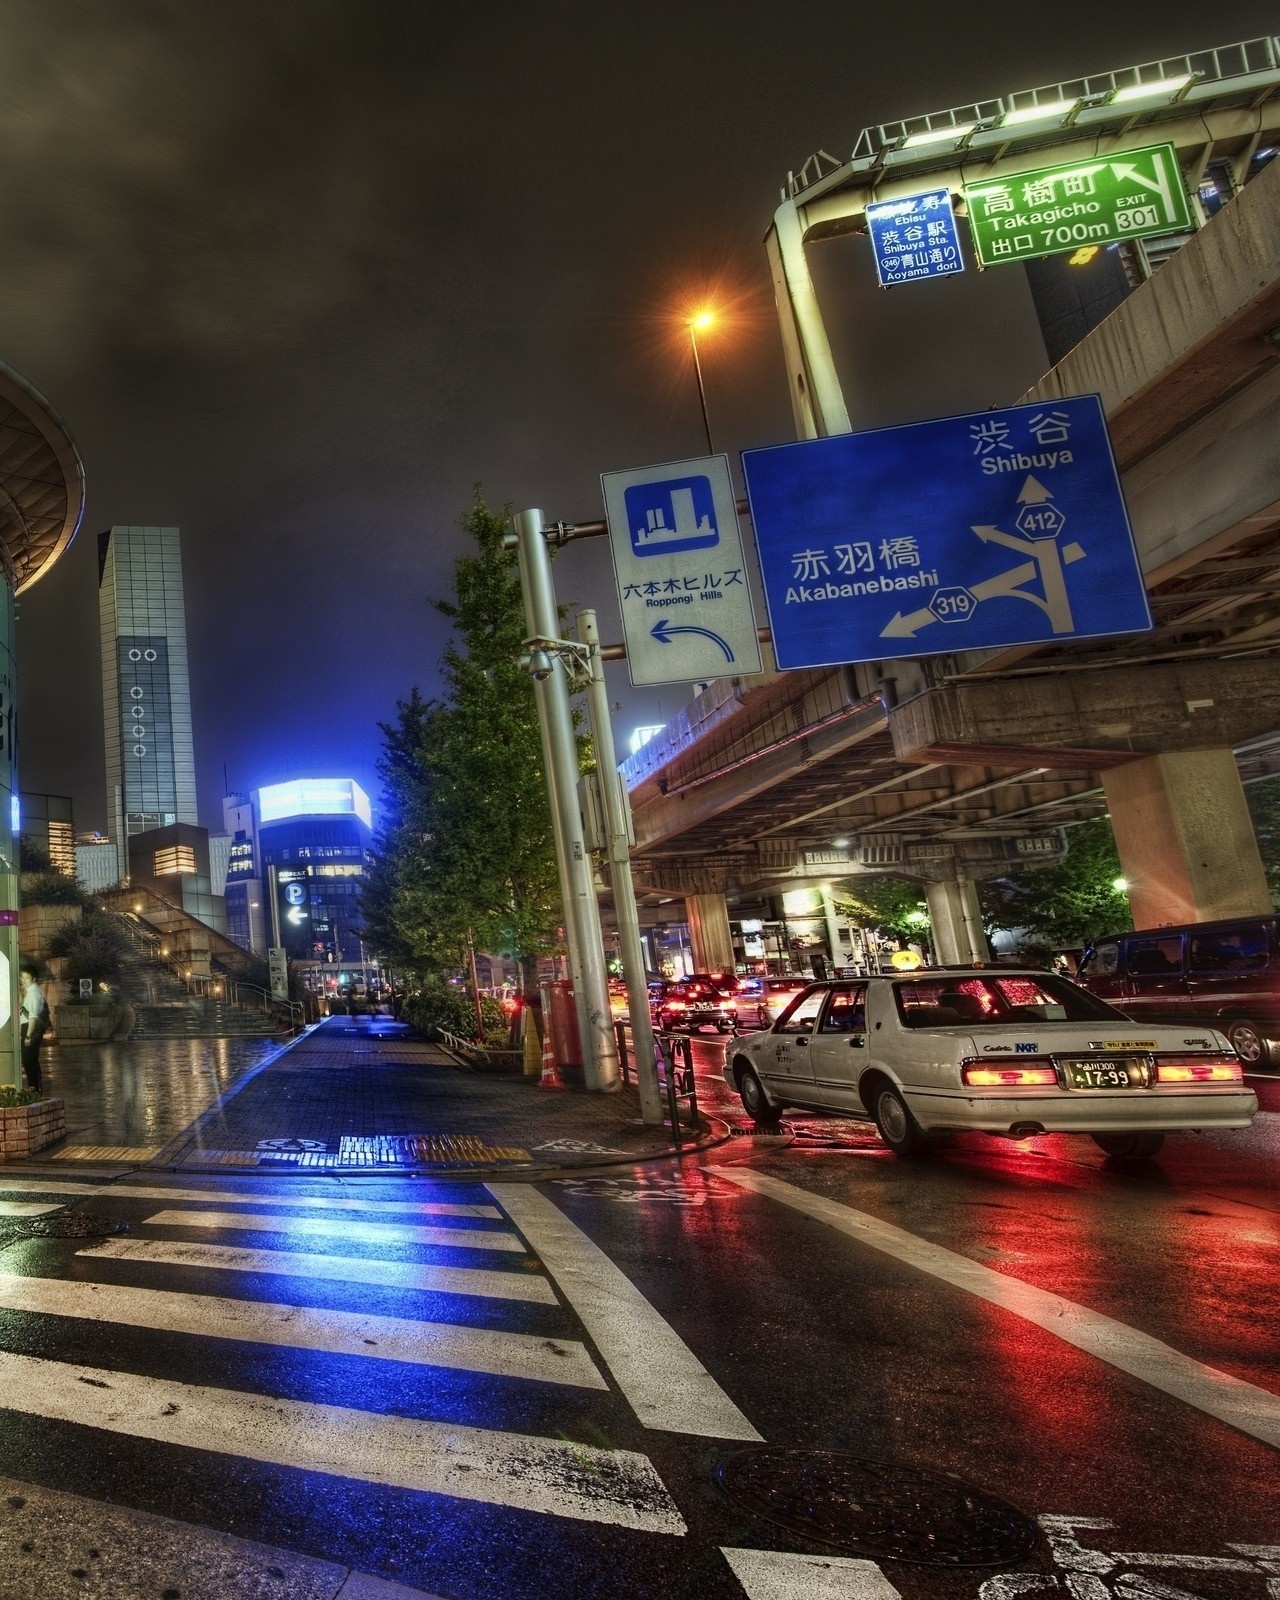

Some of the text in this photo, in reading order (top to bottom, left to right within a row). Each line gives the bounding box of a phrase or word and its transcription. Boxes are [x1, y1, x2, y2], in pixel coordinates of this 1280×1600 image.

[983, 171, 1094, 215] 高樹町
[1116, 193, 1147, 208] EXIT
[895, 214, 927, 226] Ebisu
[990, 199, 1101, 232] Takagicho
[1118, 207, 1157, 229] 301
[881, 221, 948, 246] 渋谷駅
[992, 222, 1110, 256] 出口 700m
[884, 237, 949, 255] Shibuya Sta.
[884, 259, 898, 268] 246
[900, 246, 956, 269] 青山通り
[887, 260, 958, 281] Aoyama dori
[970, 411, 1072, 455] 渋谷
[980, 447, 1074, 476] Shibuya
[1023, 512, 1059, 532] 412
[791, 537, 922, 583] 赤羽橋
[623, 570, 744, 600] 六本木ヒルズ
[784, 569, 939, 606] Akabanebashi
[646, 589, 723, 609] Roppongi Hills
[936, 595, 971, 616] 319
[1015, 1043, 1038, 1053] NKR
[1085, 1071, 1129, 1085] 17-99
